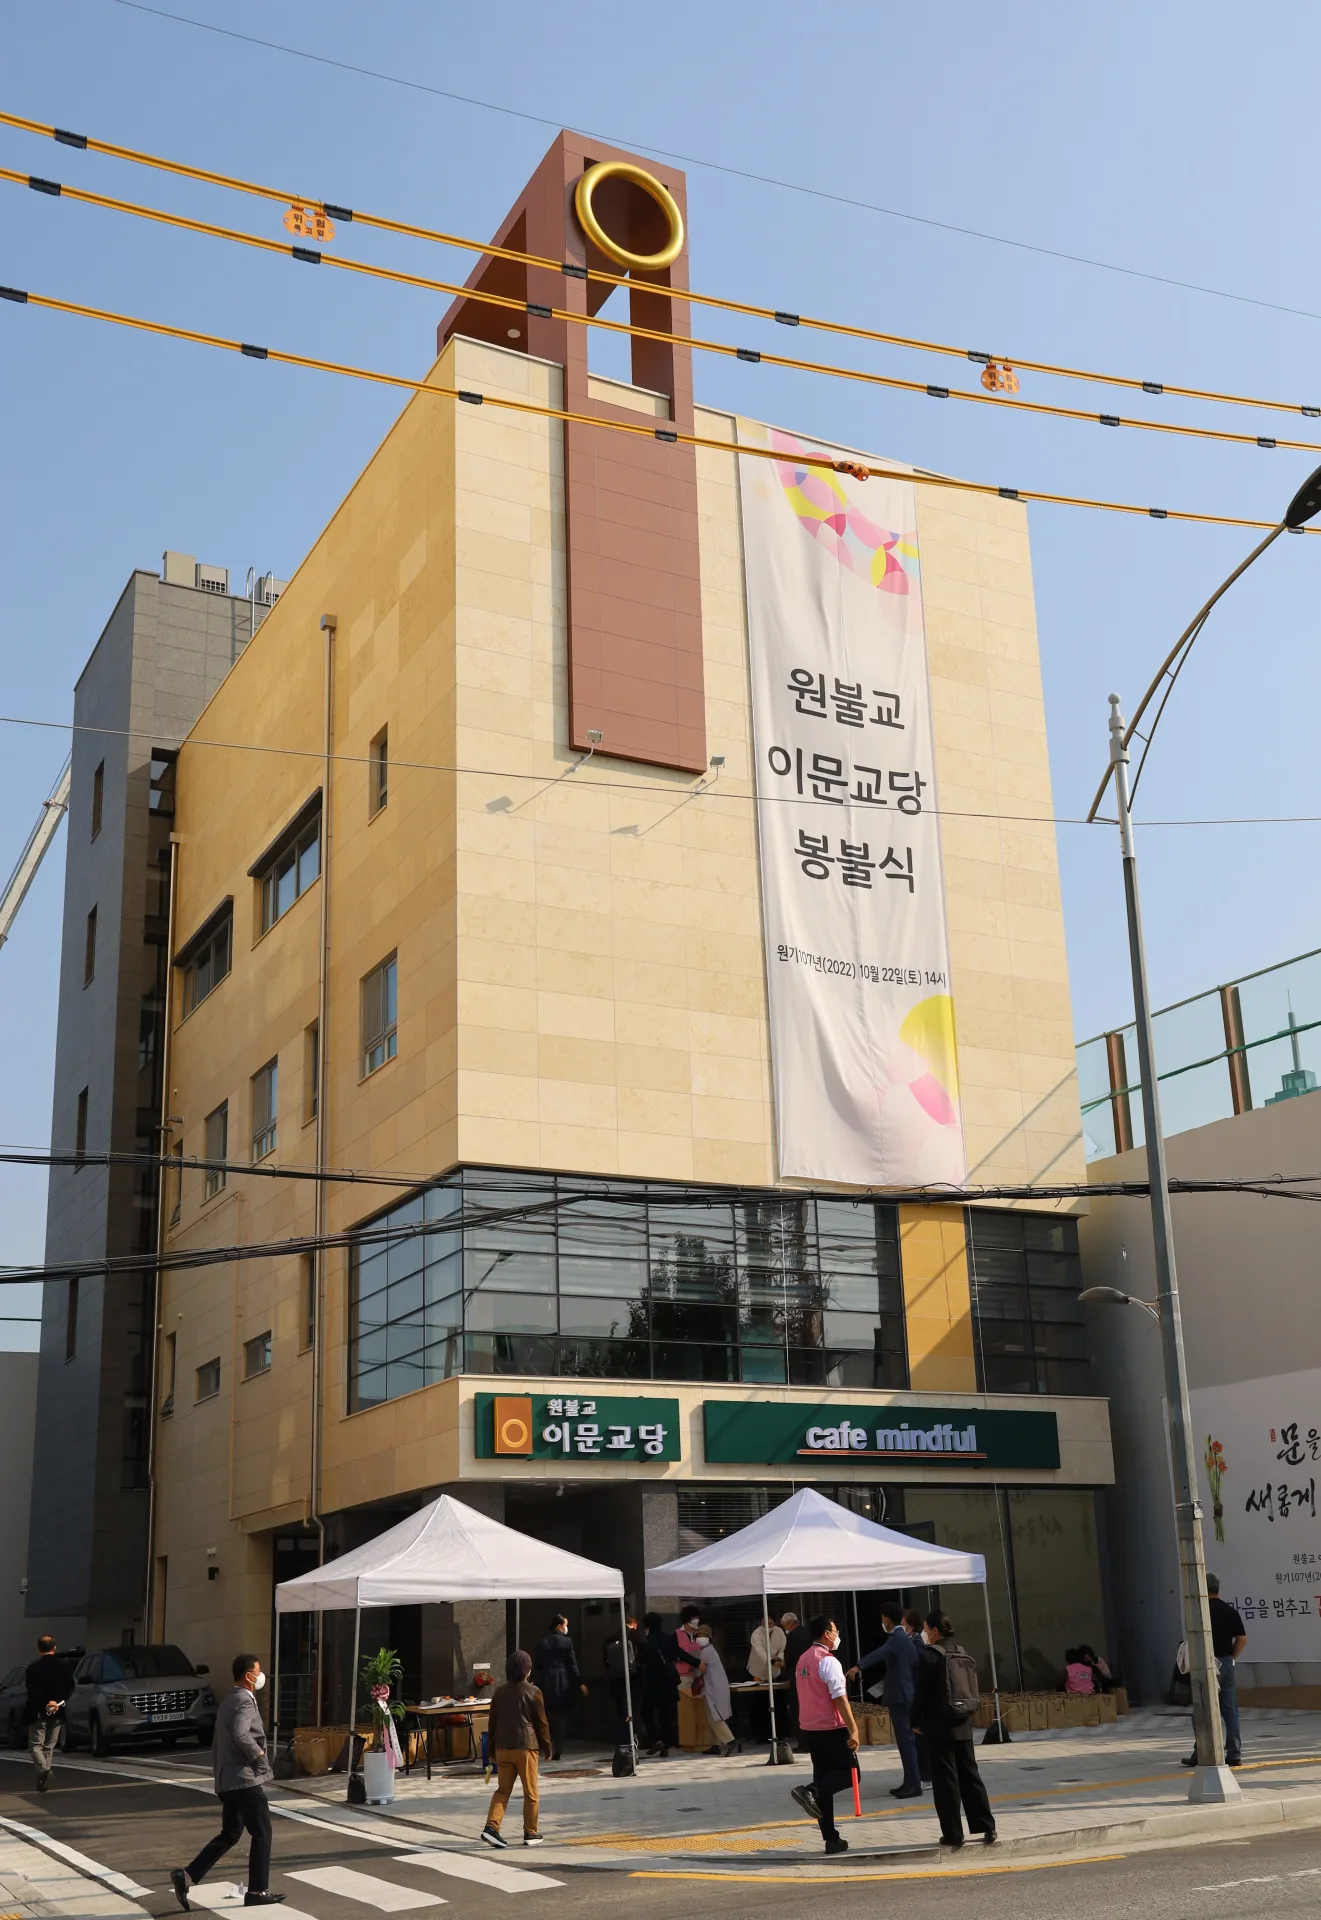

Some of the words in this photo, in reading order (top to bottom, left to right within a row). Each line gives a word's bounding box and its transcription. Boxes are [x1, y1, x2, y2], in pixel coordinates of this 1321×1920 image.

[787, 668, 905, 730] 원불교
[768, 746, 927, 816] 이문교당
[794, 828, 915, 894] 봉불식
[777, 944, 856, 979] 원기107년(2022)
[859, 963, 880, 983] 10월
[881, 966, 922, 987] 22일(토)
[924, 970, 947, 988] 14시
[546, 1398, 598, 1417] 원불교
[542, 1421, 668, 1455] 이문교당
[805, 1420, 868, 1450] cafe
[875, 1422, 977, 1452] mindful
[1276, 1422, 1321, 1466] 문을
[1245, 1477, 1316, 1522] 새롭게
[1274, 1571, 1321, 1585] 원기107년(2
[1292, 1552, 1317, 1565] 원불교
[1272, 1597, 1312, 1619] 멈추고
